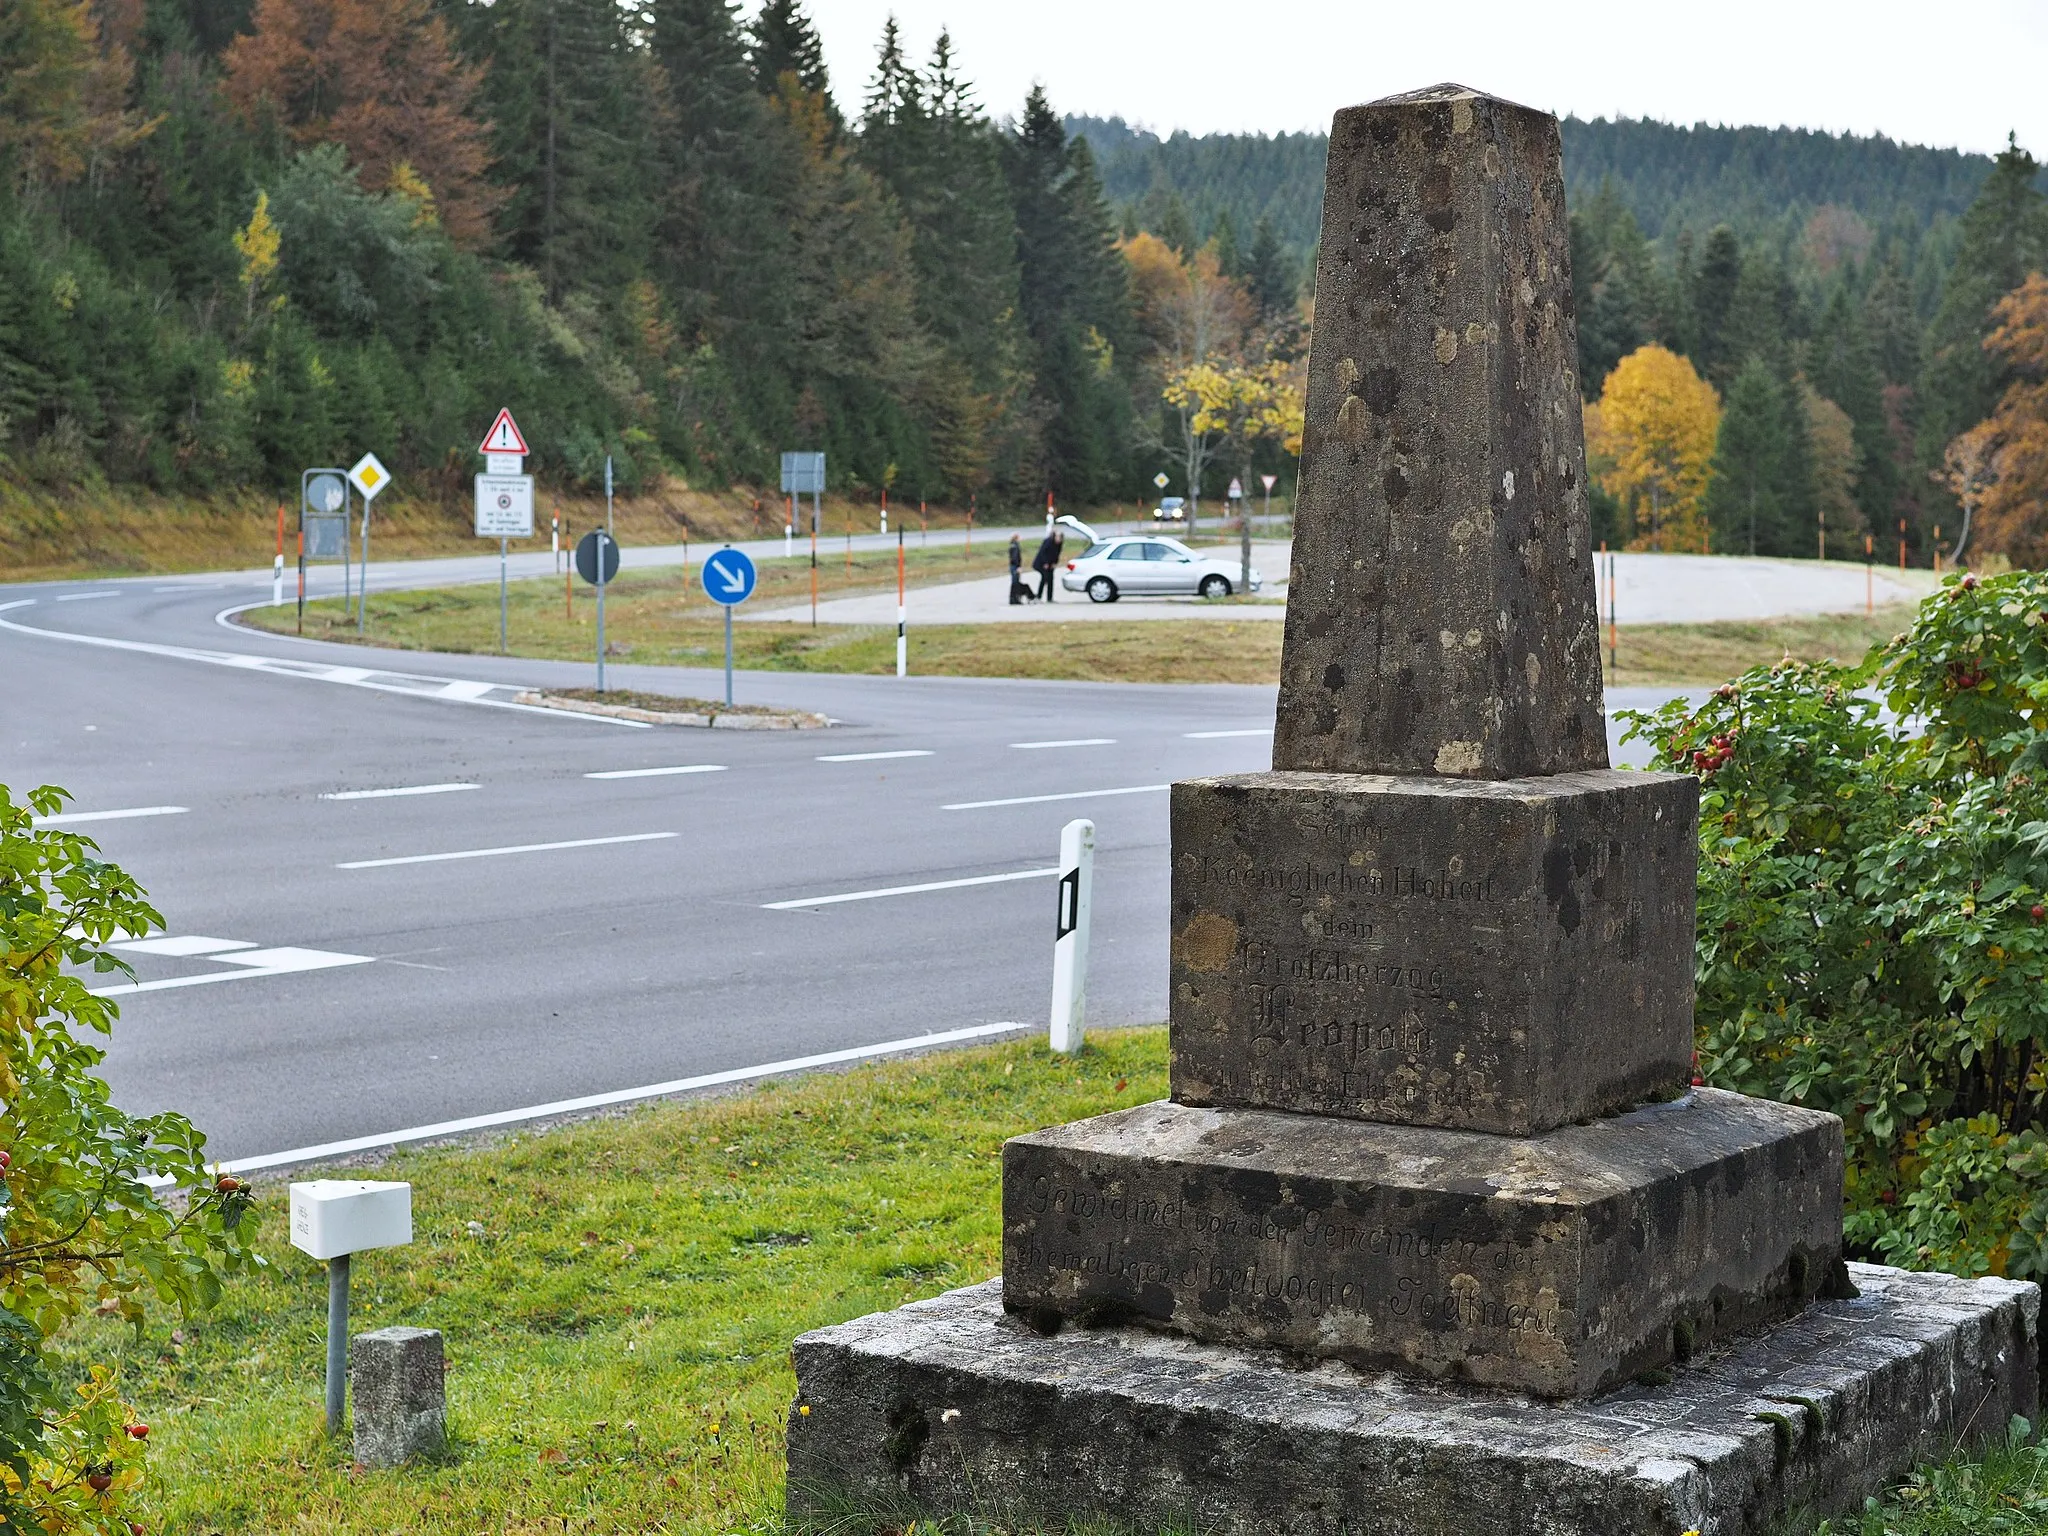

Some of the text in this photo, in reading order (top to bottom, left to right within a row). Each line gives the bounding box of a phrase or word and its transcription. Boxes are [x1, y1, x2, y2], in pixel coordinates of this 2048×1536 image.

[1201, 855, 1495, 908] Koeniglichen Hoheit
[1322, 914, 1374, 939] dem
[1196, 1212, 1237, 1236] von
[1249, 1213, 1289, 1244] den
[1303, 1208, 1479, 1265] Gemeinden
[1495, 1241, 1540, 1279] der
